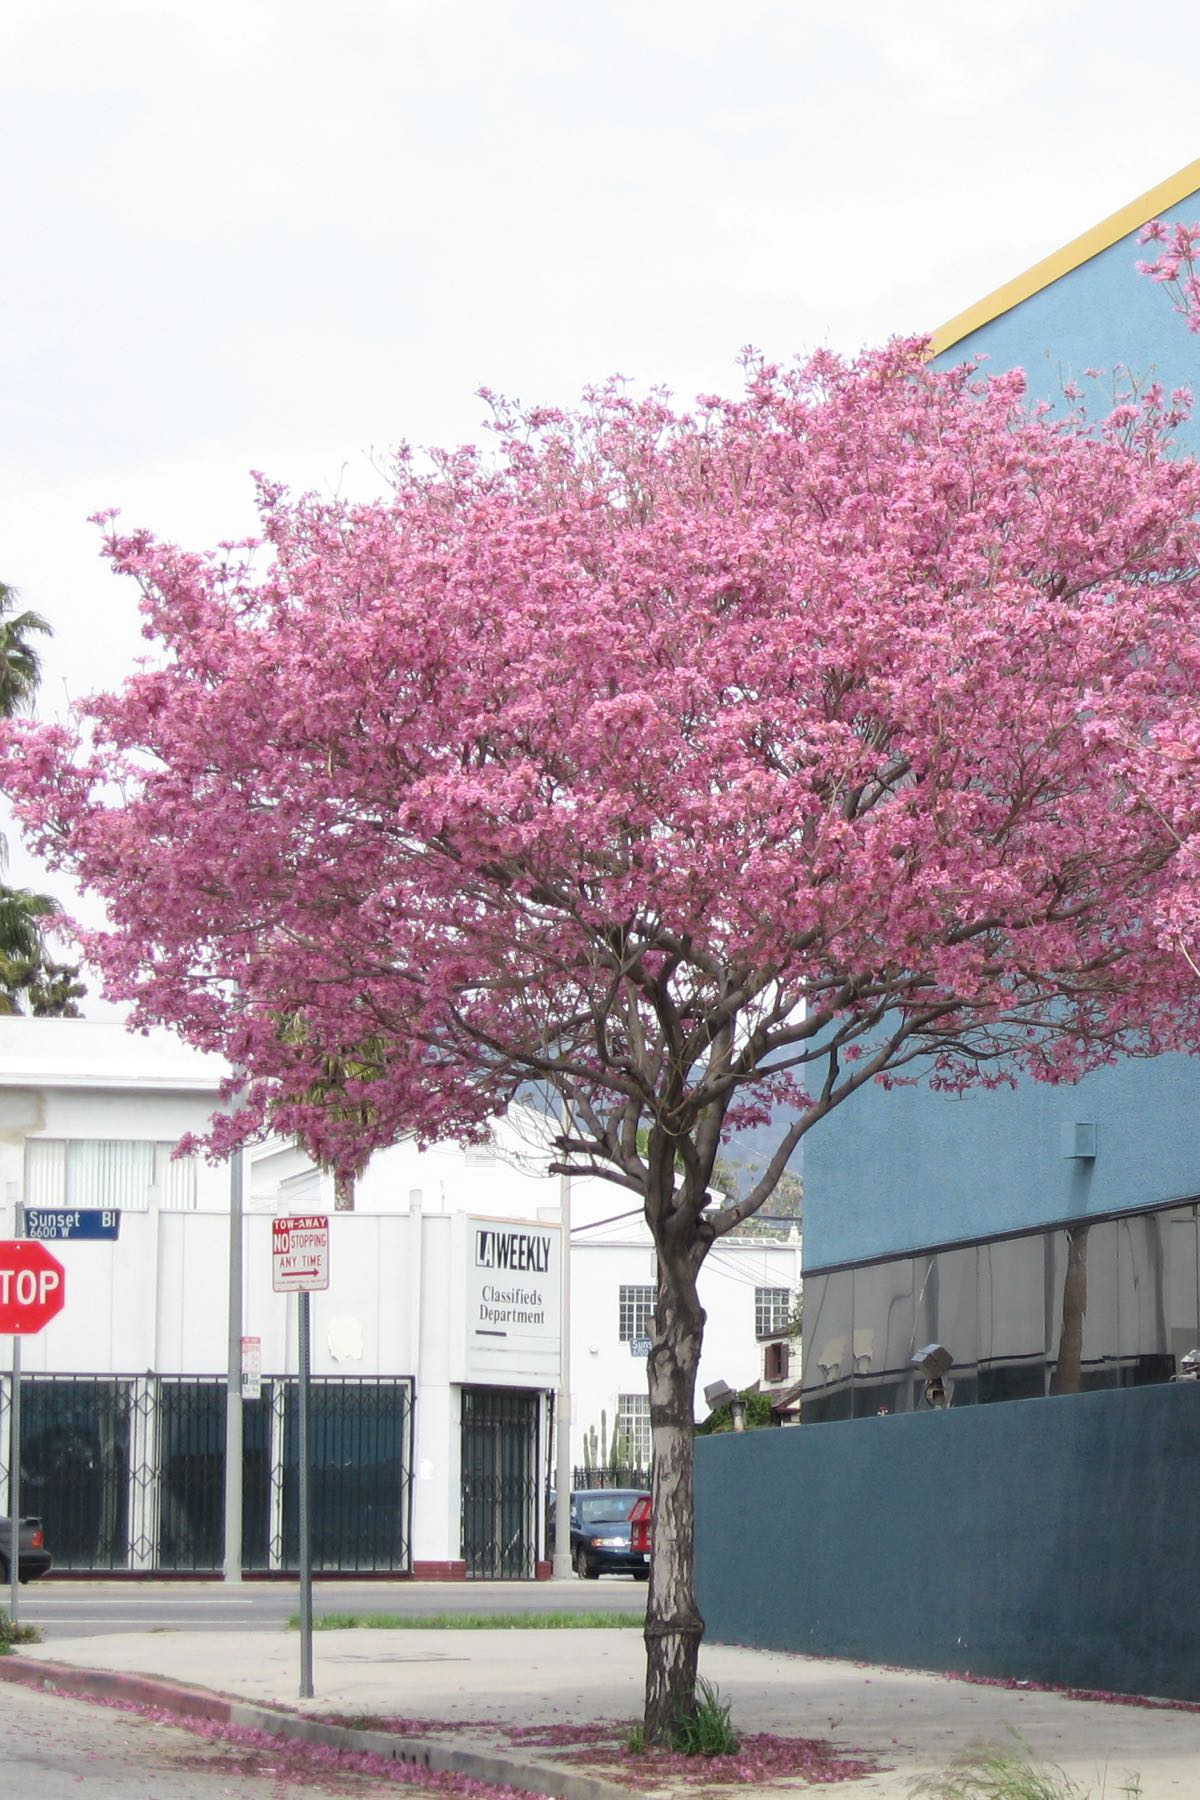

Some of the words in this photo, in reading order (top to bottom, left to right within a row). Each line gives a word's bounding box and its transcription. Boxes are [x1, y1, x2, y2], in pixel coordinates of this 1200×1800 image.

[29, 1211, 80, 1227] Sunset
[101, 1211, 116, 1227] Bl
[274, 1217, 326, 1230] TOW-AWAY
[30, 1227, 57, 1238] 6600
[61, 1227, 70, 1238] W
[274, 1233, 288, 1252] NO
[291, 1233, 327, 1249] STOPPING
[497, 1232, 551, 1272] WEEKLY
[280, 1256, 297, 1268] ANY
[302, 1254, 321, 1267] TIME
[0, 1269, 60, 1305] TOP
[482, 1285, 543, 1306] Classifieds
[480, 1304, 545, 1325] Department
[632, 1339, 652, 1350] Suns
